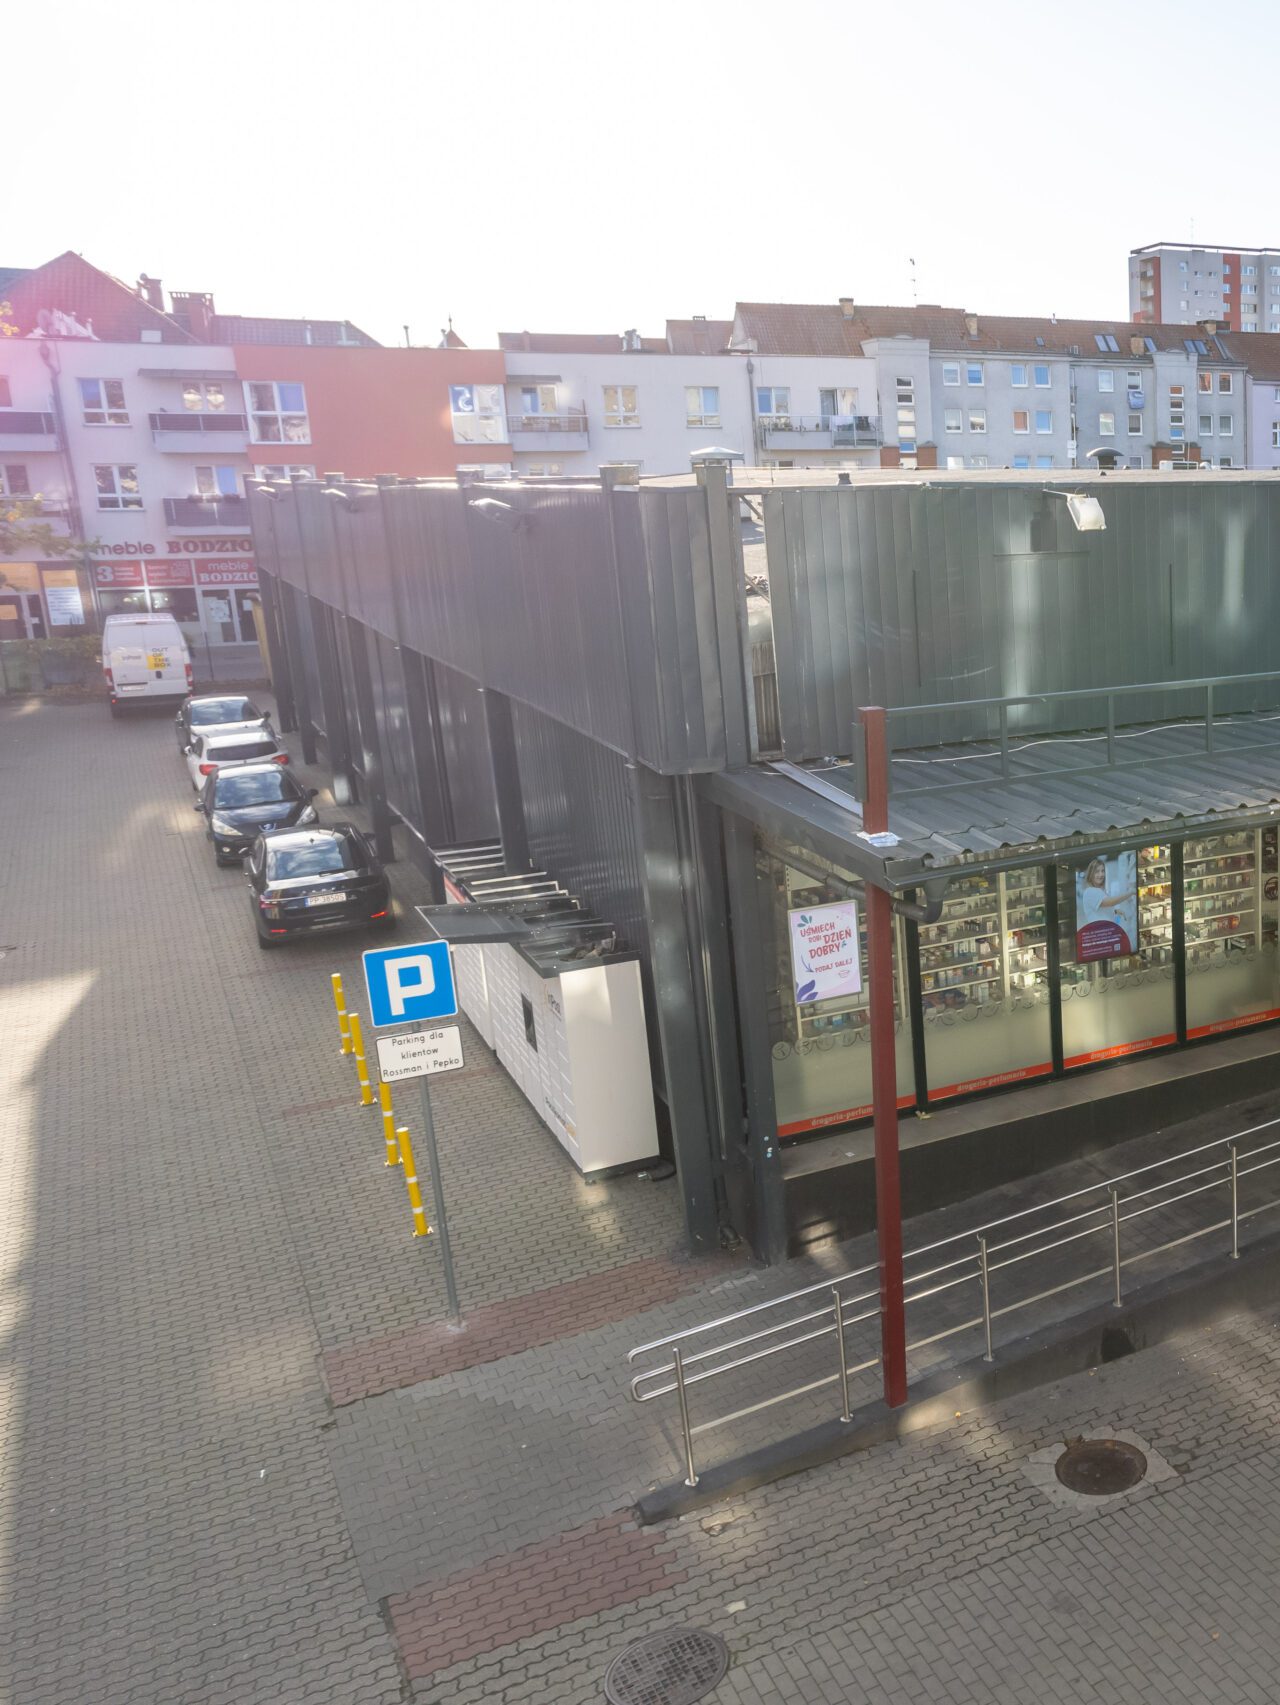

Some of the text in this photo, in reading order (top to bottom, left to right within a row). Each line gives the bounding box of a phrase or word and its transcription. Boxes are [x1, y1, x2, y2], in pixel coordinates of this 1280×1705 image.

[97, 541, 155, 555] meble
[208, 560, 248, 570] meble
[97, 566, 113, 582] 3
[800, 921, 836, 938] UŚMIECH
[823, 926, 852, 944] DZIEŃ
[808, 942, 841, 959] DOBRY
[815, 958, 853, 973] PODAJ DALEJ
[384, 954, 435, 1016] P
[391, 1031, 444, 1046] Parking dla
[401, 1048, 439, 1060] klientow
[382, 1058, 460, 1077] Rossman i Pepko
[811, 1106, 874, 1126] drogeria-perfum
